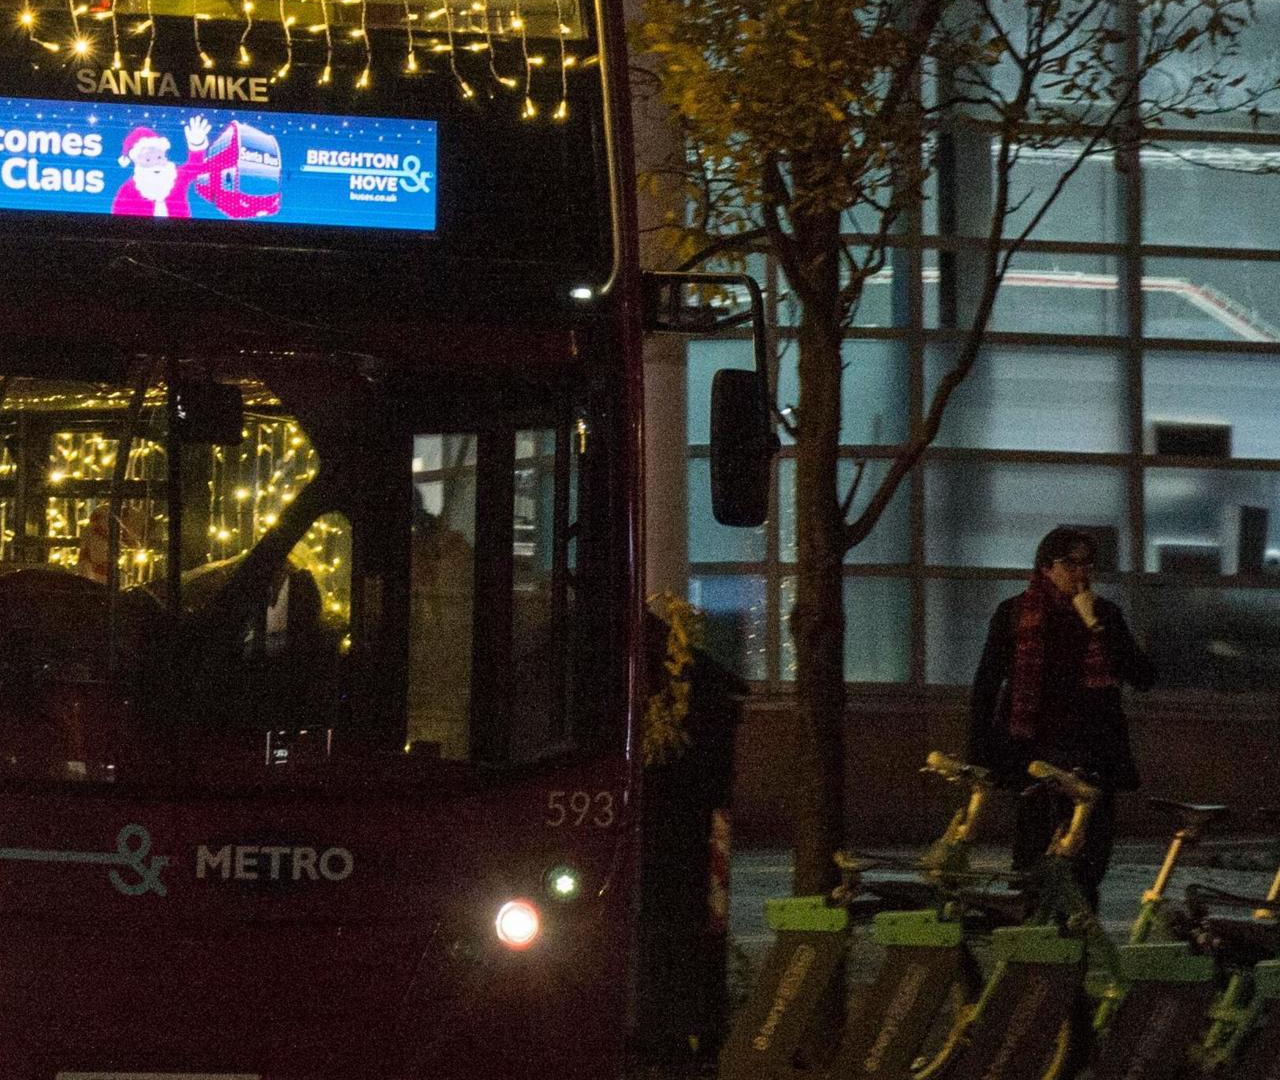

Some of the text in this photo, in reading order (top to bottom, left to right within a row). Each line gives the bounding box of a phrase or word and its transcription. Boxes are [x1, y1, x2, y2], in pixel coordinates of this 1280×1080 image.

[77, 69, 270, 103] SANTA MIKE
[240, 146, 281, 167] Santa Bus
[306, 149, 399, 169] BRIGHTON
[0, 156, 105, 193] Claus
[350, 175, 398, 192] HOVE
[349, 192, 398, 203] buses.co.uk
[544, 791, 614, 827] 593
[195, 845, 354, 881] METRO
